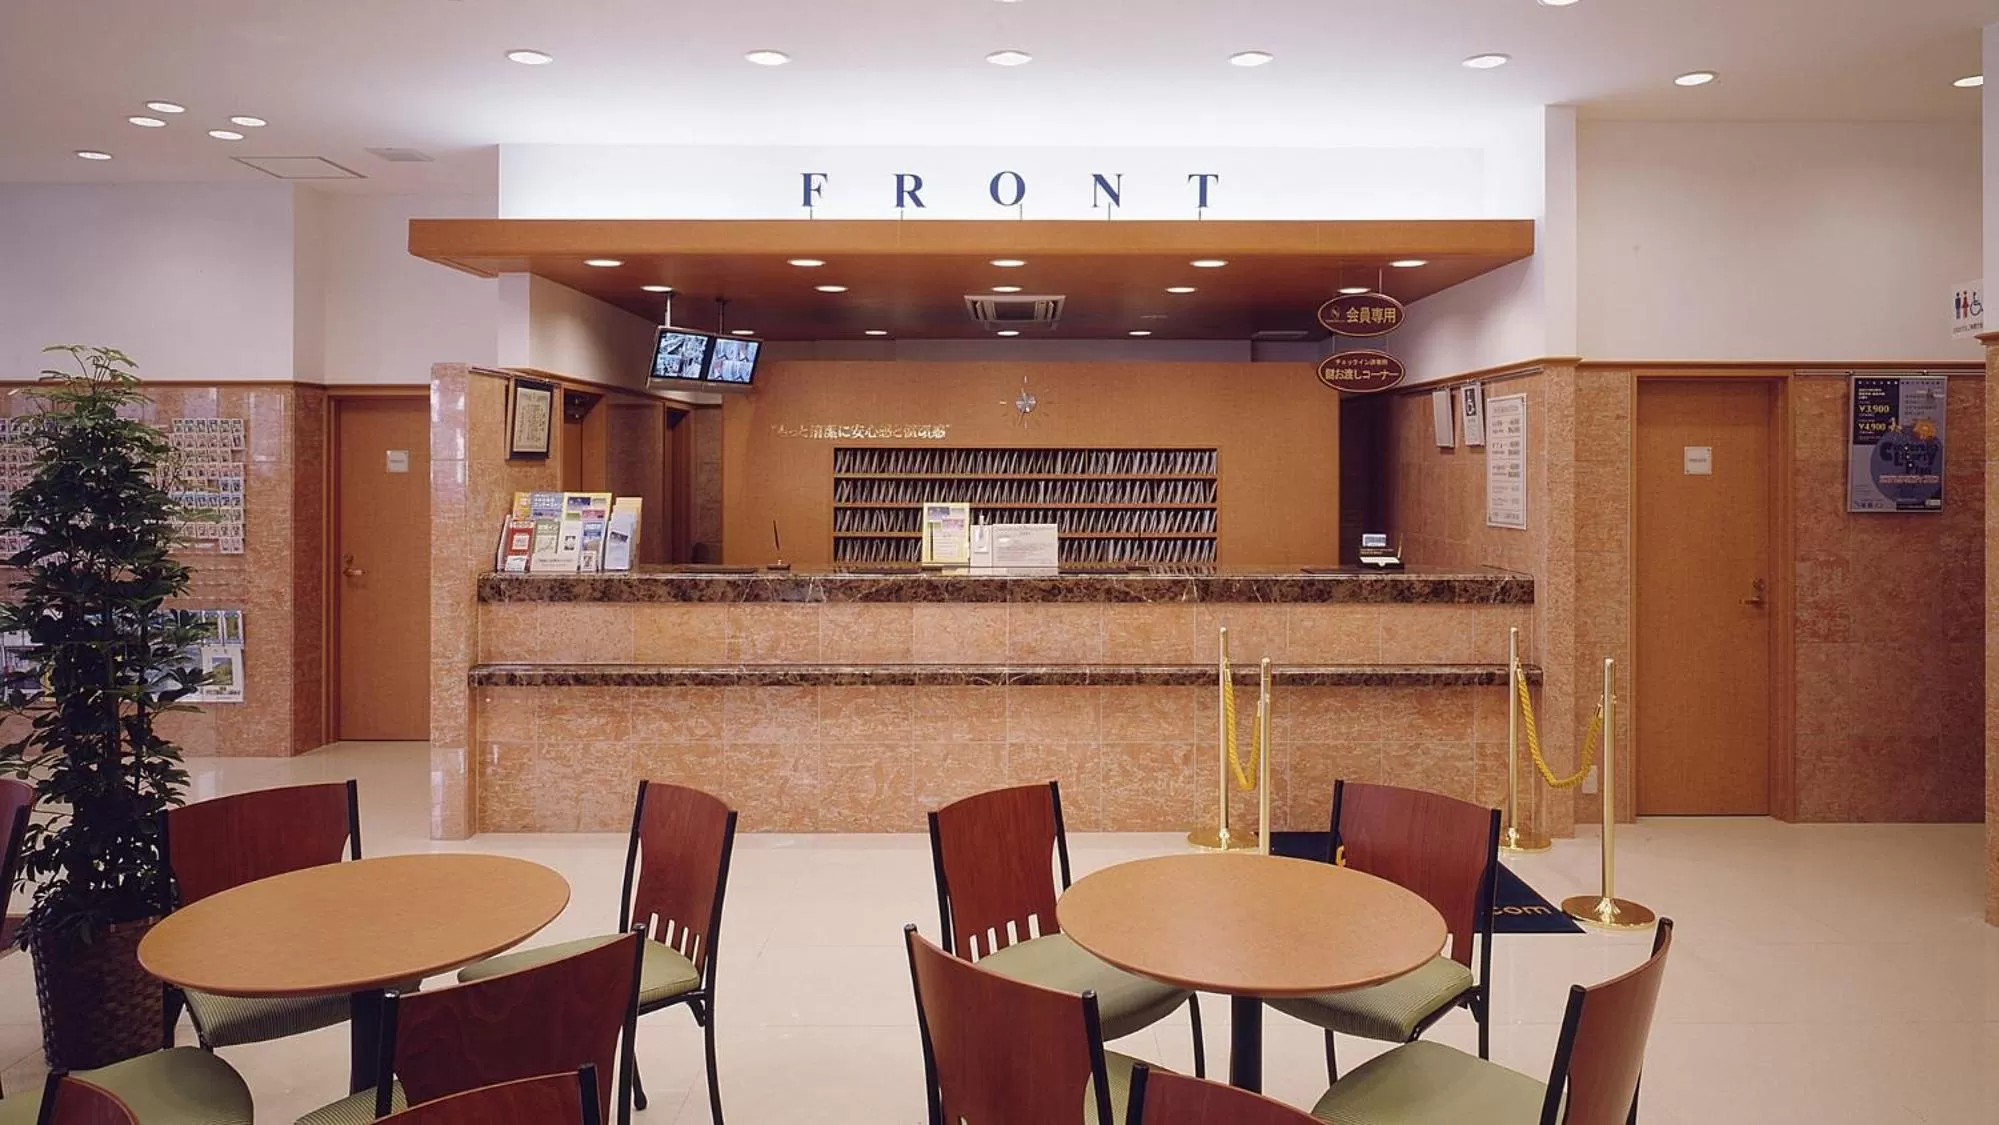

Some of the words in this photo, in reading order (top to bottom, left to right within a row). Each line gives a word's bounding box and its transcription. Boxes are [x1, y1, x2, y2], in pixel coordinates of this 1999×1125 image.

[801, 171, 1219, 208] FRONT
[1346, 307, 1396, 323] 会員専用
